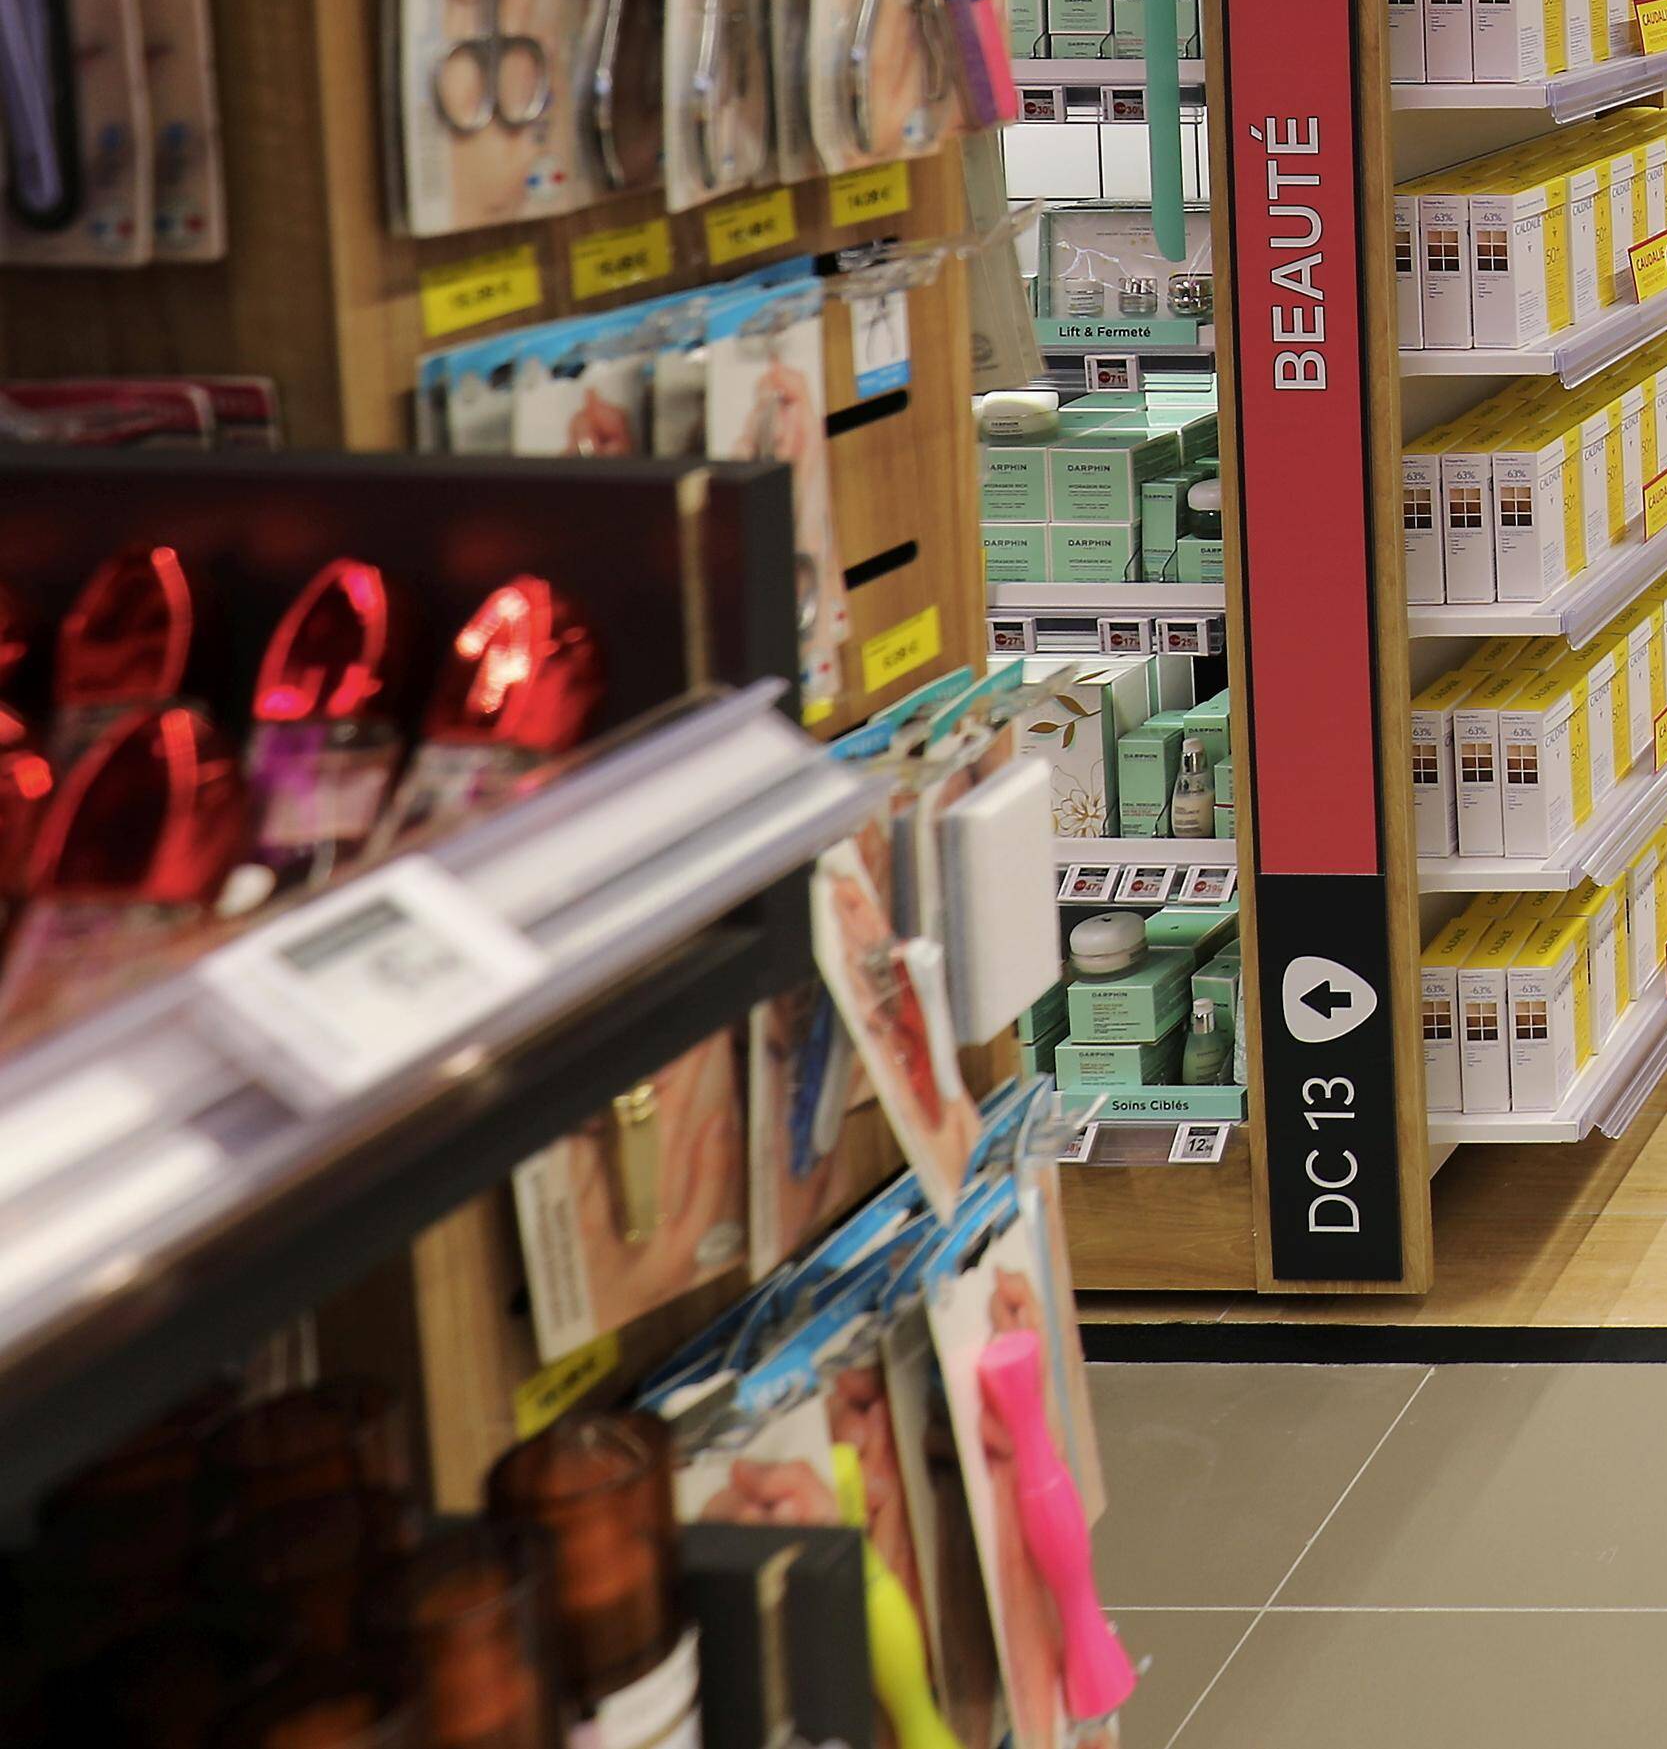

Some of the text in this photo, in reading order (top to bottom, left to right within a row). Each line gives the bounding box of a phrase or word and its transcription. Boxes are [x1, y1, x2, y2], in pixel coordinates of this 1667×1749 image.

[1249, 115, 1328, 391] BEAUTÉ
[1636, 247, 1665, 271] CAUDALIE
[1058, 325, 1151, 338] Lift & Fermeté
[1453, 470, 1475, 481] -63%
[1112, 1099, 1189, 1111] Soins Ciblés
[1302, 1076, 1361, 1233] DC 13
